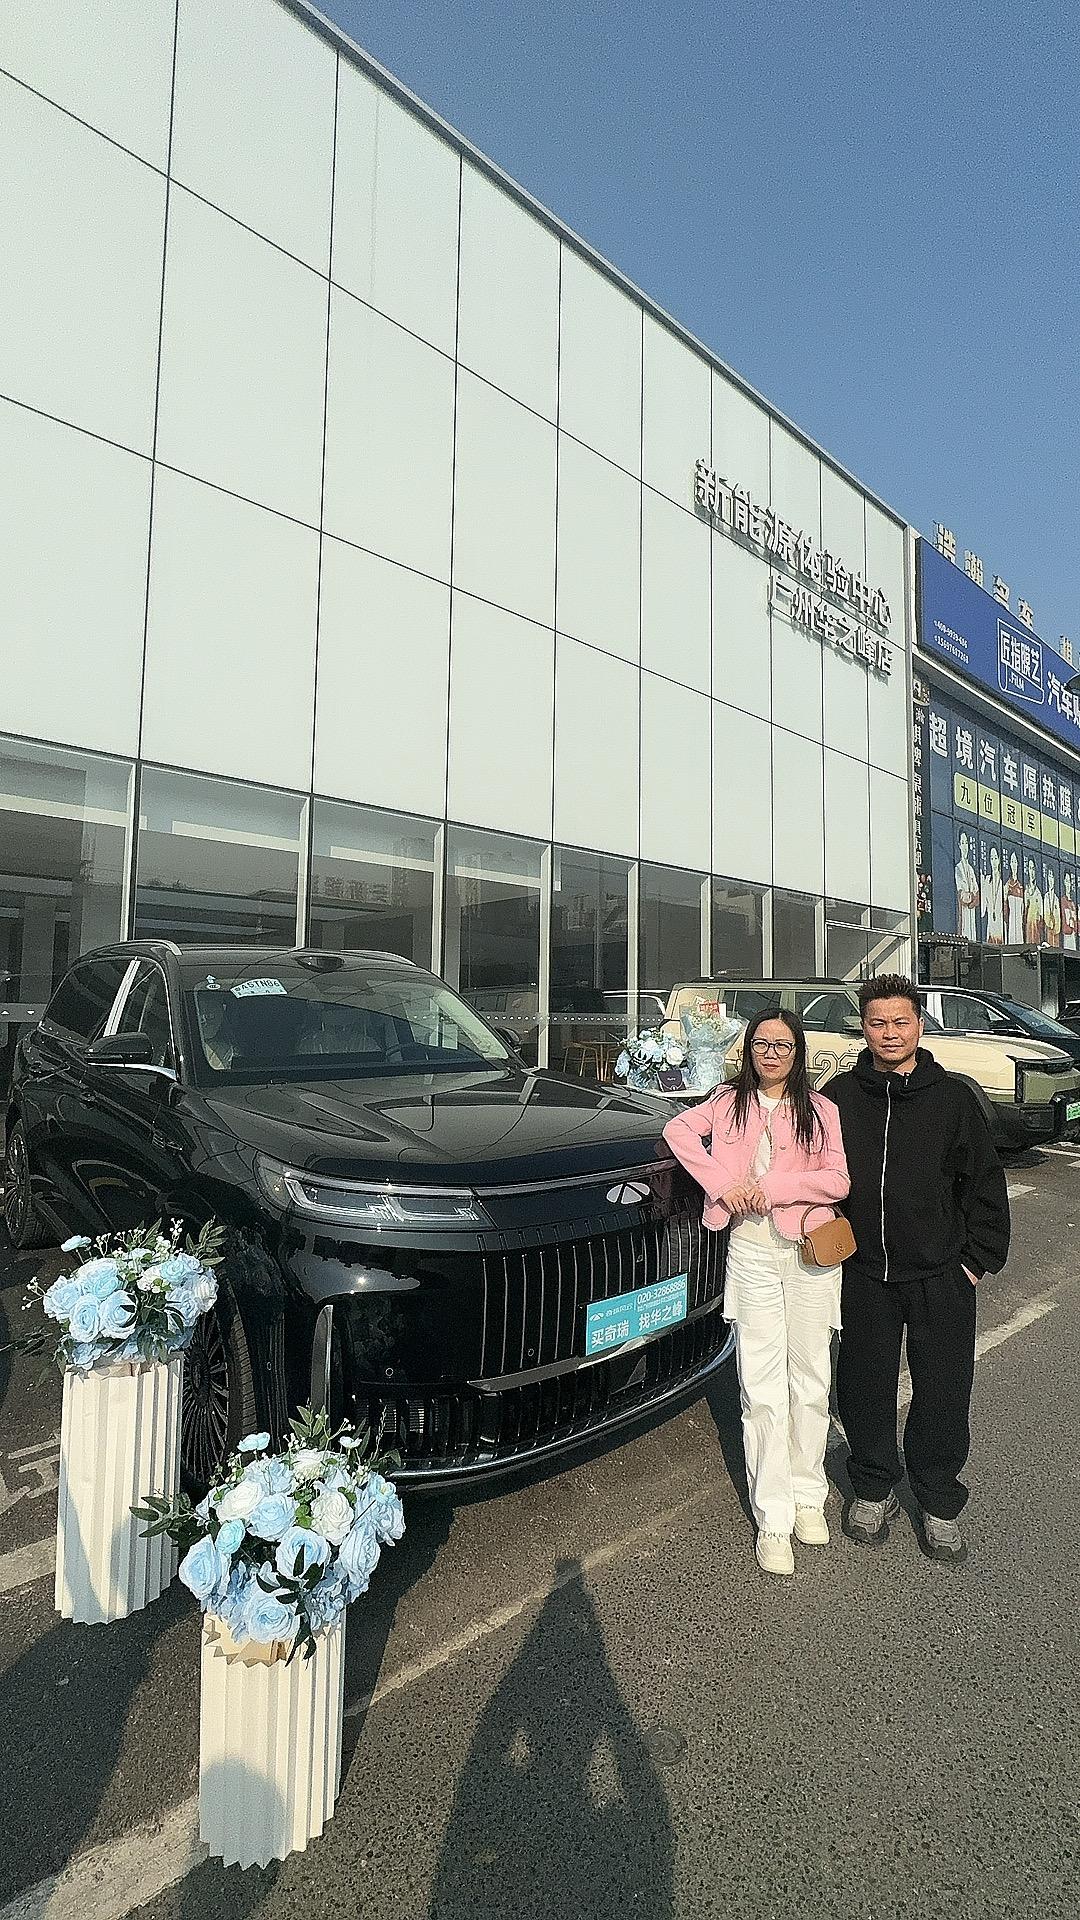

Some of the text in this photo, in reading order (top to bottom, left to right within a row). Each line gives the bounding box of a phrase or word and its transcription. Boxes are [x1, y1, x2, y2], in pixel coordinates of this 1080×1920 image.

[694, 458, 891, 627] 新能源体验中心
[929, 711, 1080, 822] 超境汽车隔热膜
[960, 781, 1037, 832] 九位冠军
[591, 1320, 630, 1348] 买奇瑞
[638, 1300, 683, 1331] 找华之峰
